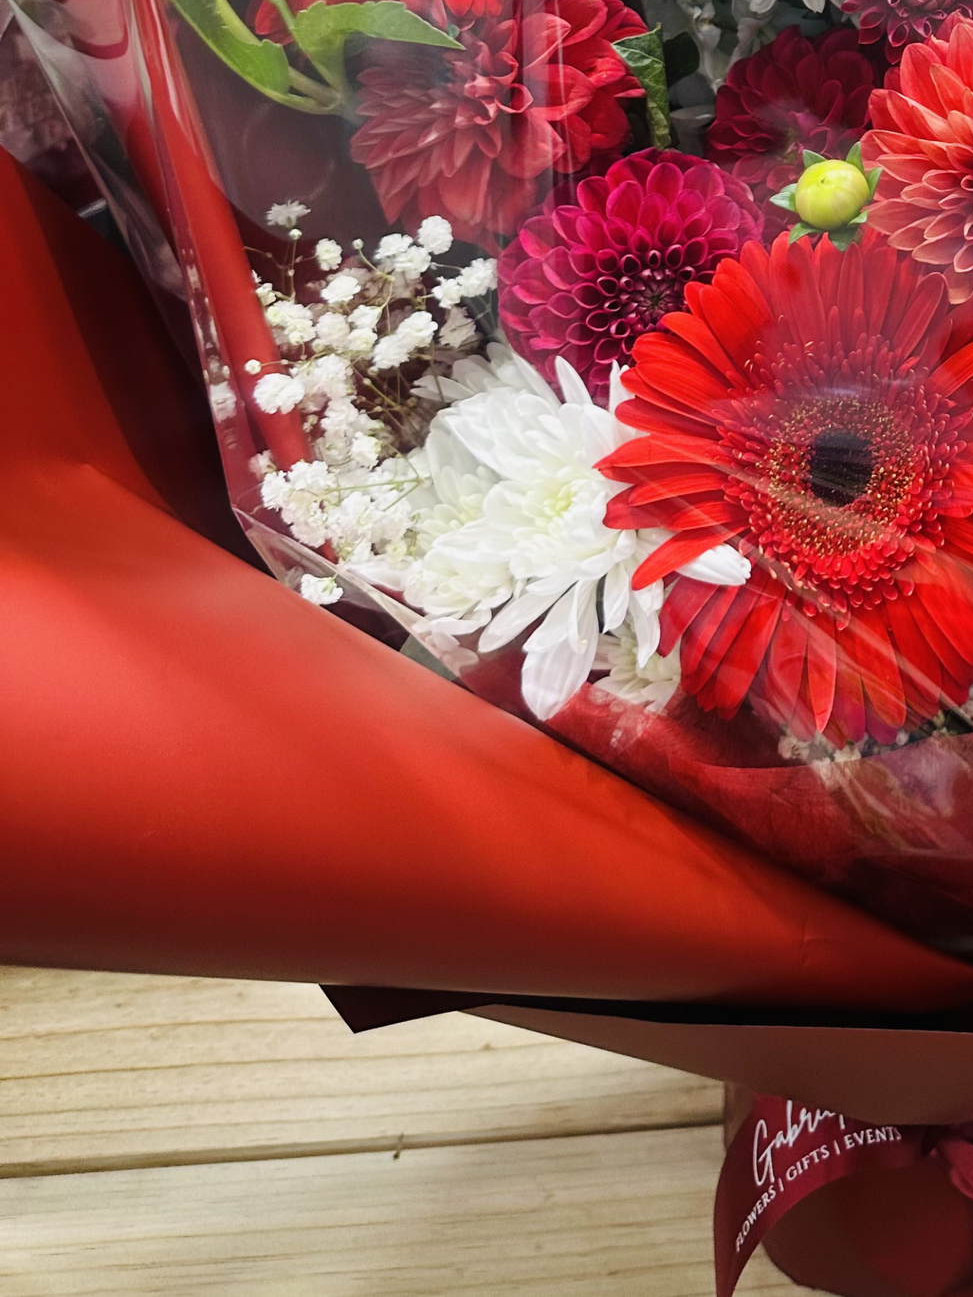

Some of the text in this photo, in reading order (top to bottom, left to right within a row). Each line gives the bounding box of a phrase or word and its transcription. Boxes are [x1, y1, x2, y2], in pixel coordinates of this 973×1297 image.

[735, 1184, 777, 1252] FLOWERS
[786, 1144, 830, 1181] GIFTS
[844, 1126, 902, 1150] EVENTS
